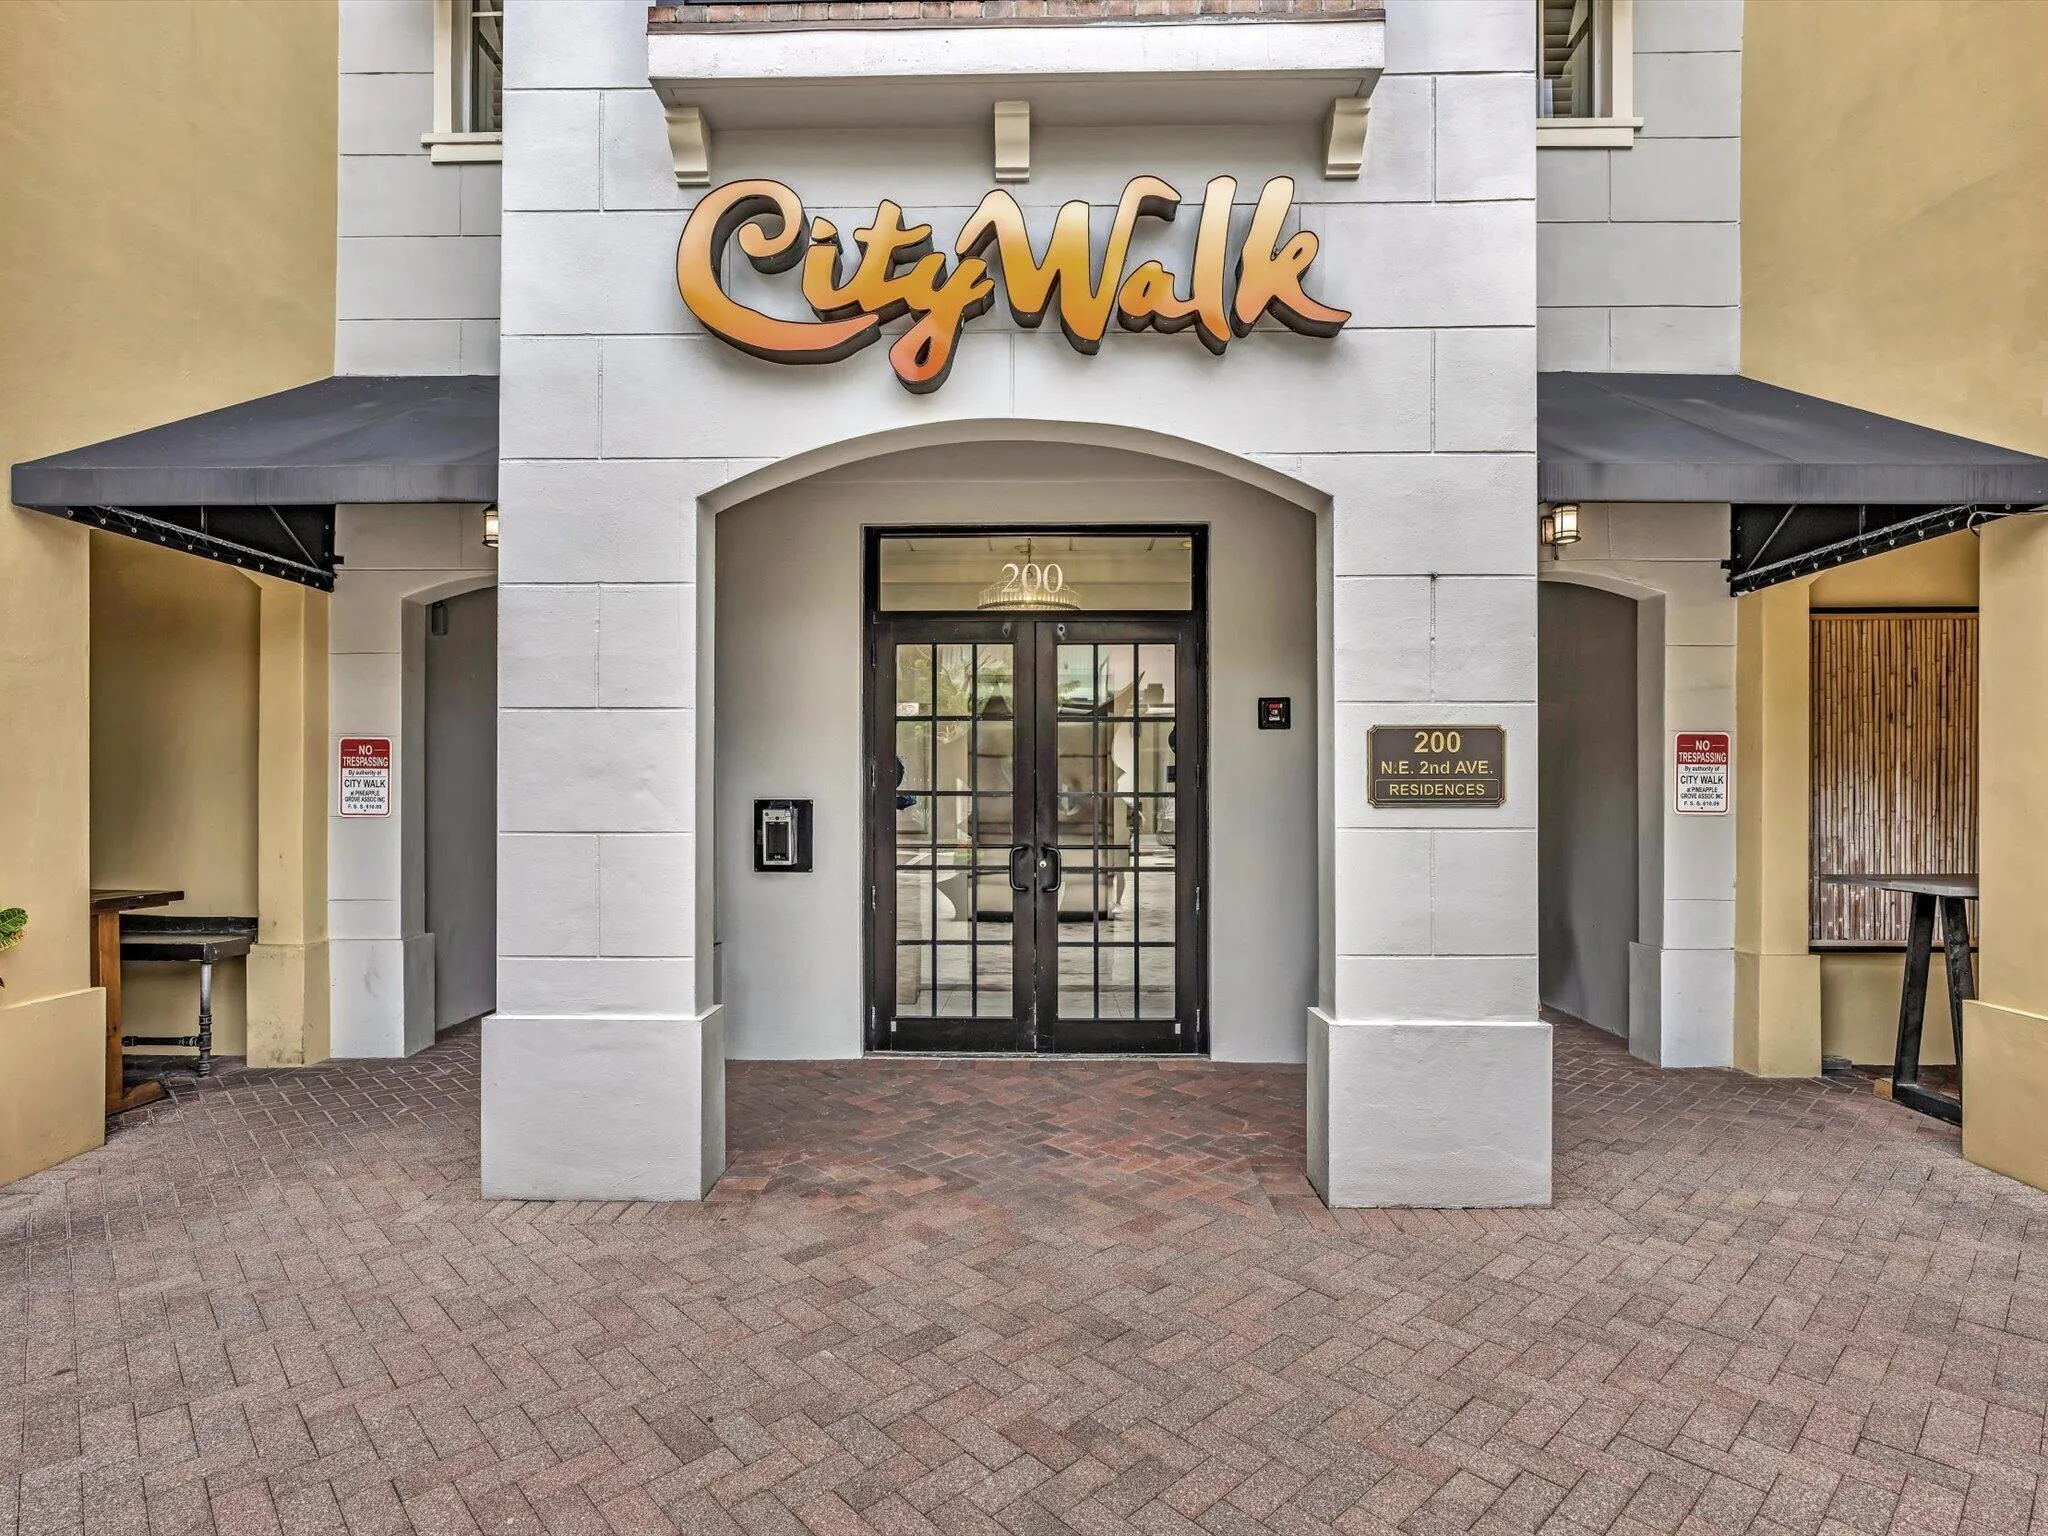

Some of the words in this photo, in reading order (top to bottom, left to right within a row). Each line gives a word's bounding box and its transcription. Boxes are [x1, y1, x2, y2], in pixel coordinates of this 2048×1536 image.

[1001, 563, 1063, 594] 200
[1413, 731, 1462, 753] 200
[1695, 740, 1710, 751] NO
[358, 745, 373, 755] NO
[342, 756, 389, 767] TRESPASSING
[1678, 752, 1727, 763] TRESPASSING
[1381, 760, 1414, 775] N.E.
[1419, 760, 1450, 775] 2nd
[1455, 760, 1494, 775] AVE.
[344, 779, 361, 788] CITY
[363, 779, 386, 788] WALK
[1680, 775, 1698, 785] CITY
[1700, 775, 1724, 785] WALK
[1389, 783, 1485, 796] RESIDENCES
